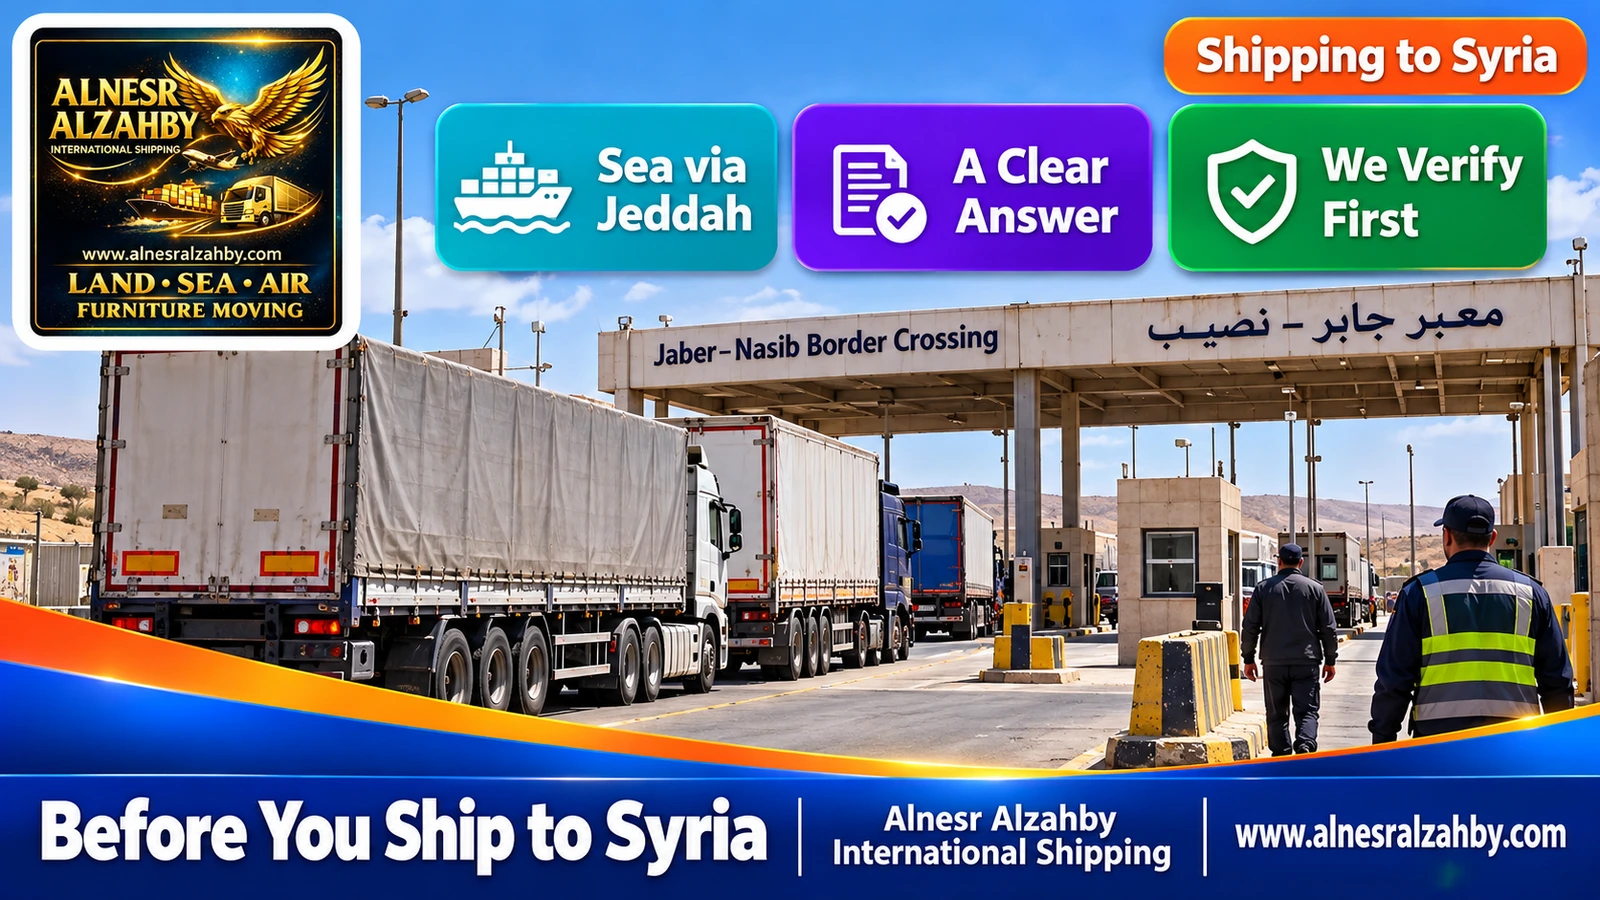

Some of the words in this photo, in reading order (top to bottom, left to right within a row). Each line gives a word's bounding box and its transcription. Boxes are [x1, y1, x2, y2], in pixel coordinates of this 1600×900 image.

[807, 329, 888, 357] Border
[893, 323, 999, 355] Crossing
[1148, 307, 1270, 351] نصيب
[1311, 301, 1395, 344] جابر
[1405, 307, 1504, 340] معبر
